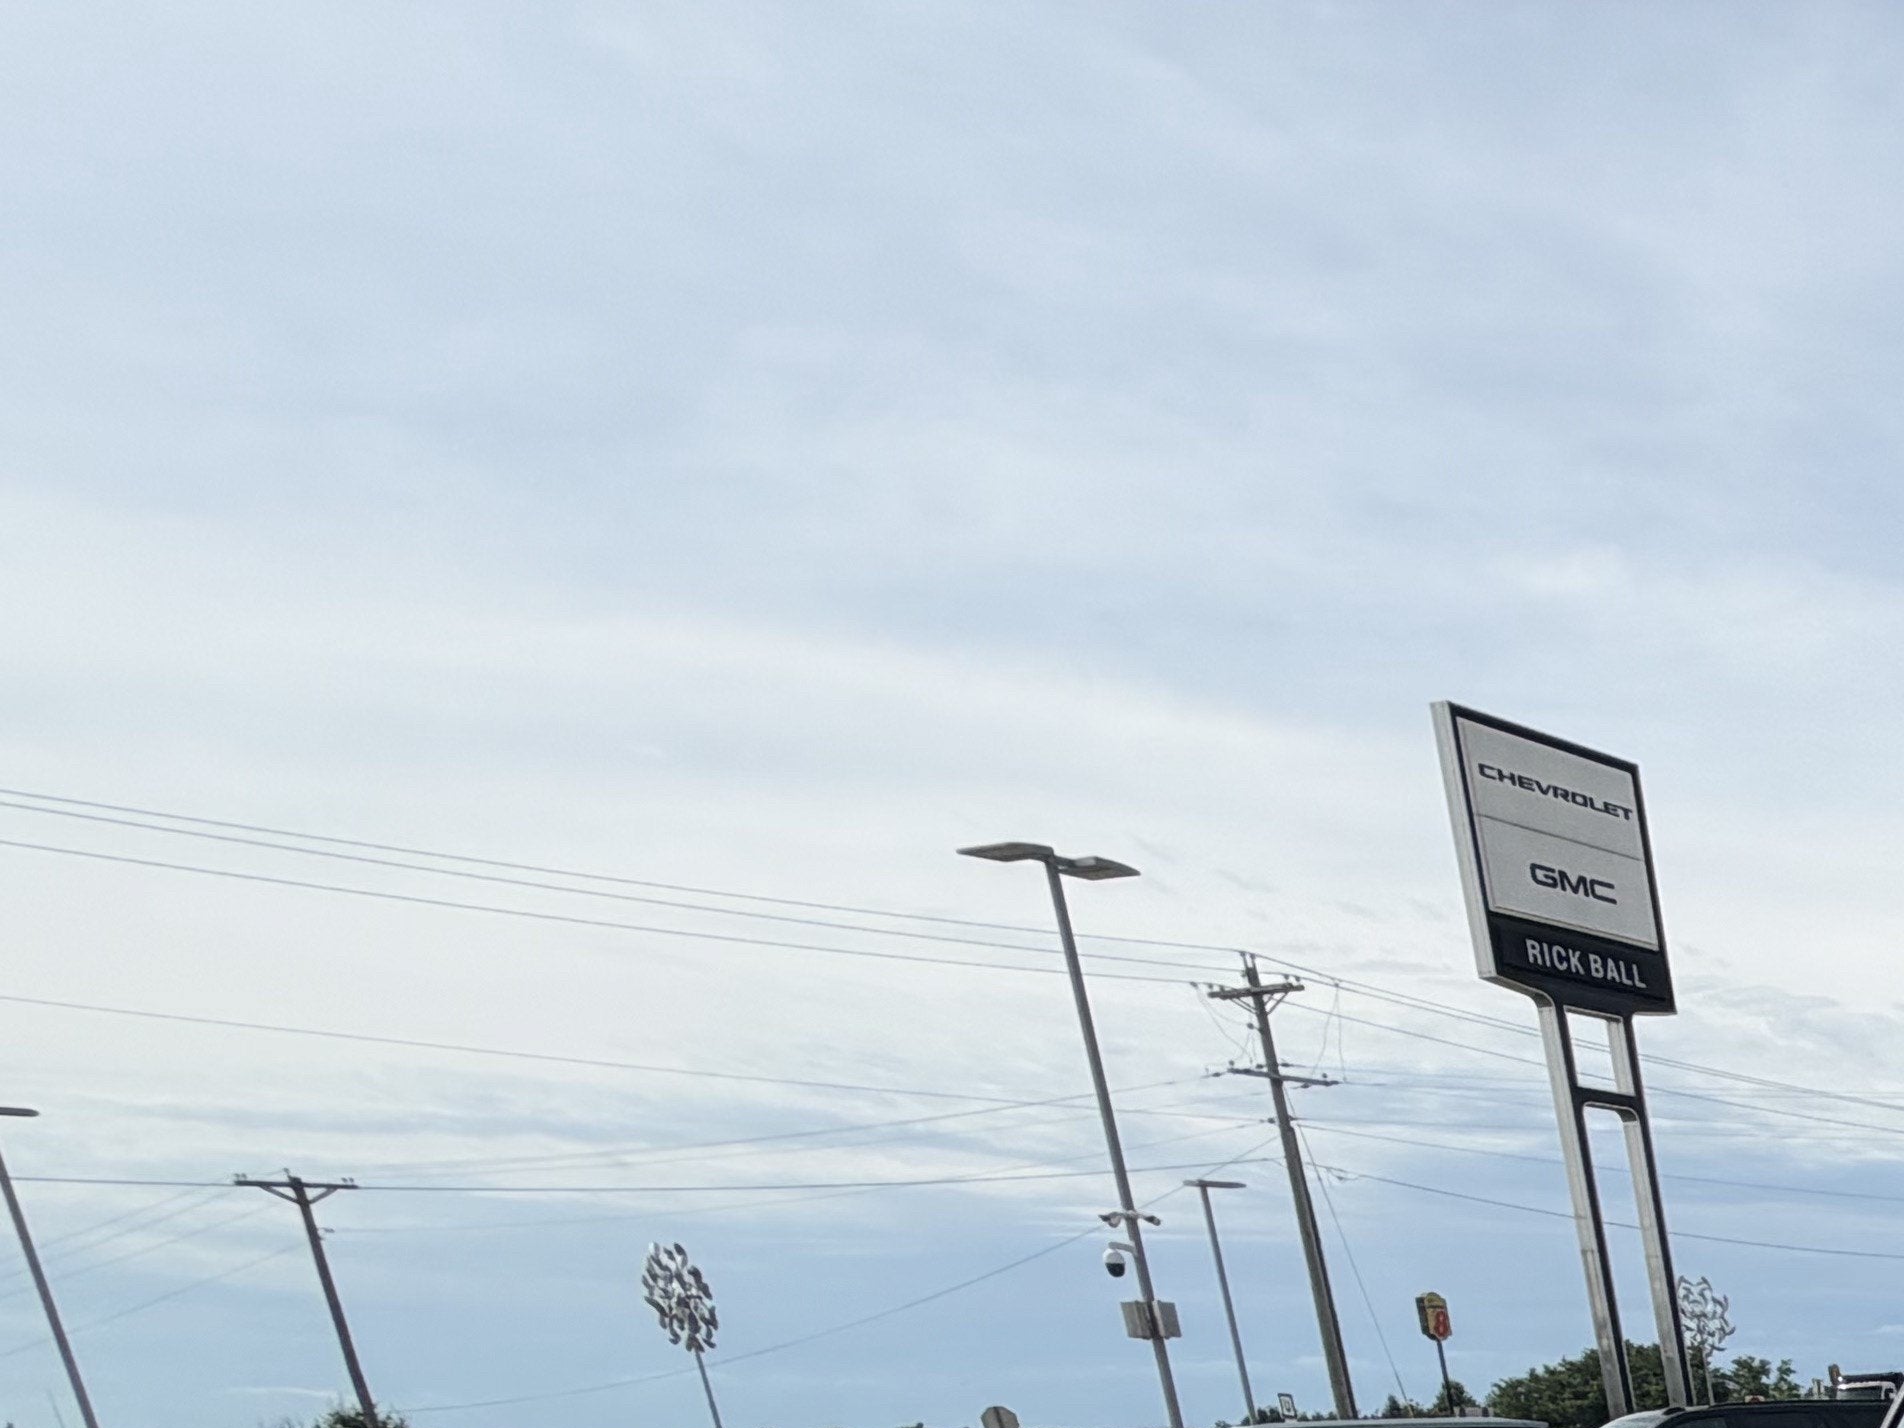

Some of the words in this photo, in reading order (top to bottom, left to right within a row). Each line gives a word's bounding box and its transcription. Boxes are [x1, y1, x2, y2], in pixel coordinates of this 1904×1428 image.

[1478, 763, 1633, 821] CHEVROLET
[1529, 862, 1618, 905] GMC
[1525, 939, 1584, 976] RICK
[1589, 953, 1648, 989] BALL
